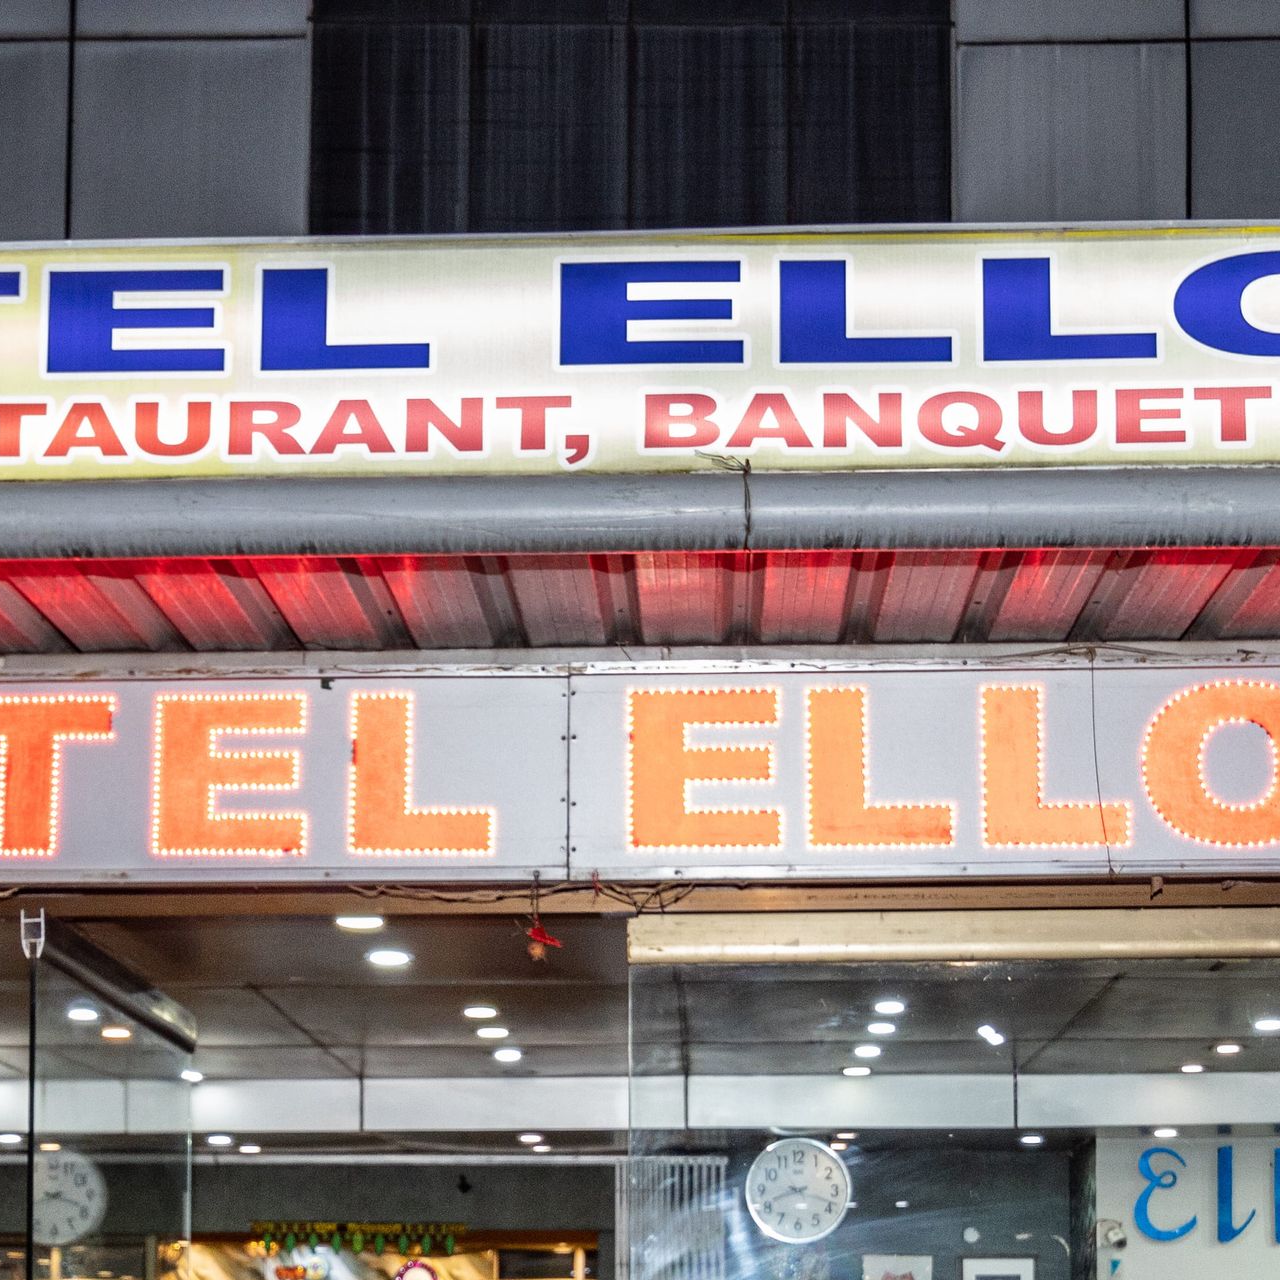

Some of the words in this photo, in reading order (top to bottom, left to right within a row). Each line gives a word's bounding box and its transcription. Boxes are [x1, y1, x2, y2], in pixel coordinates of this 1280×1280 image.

[644, 386, 1272, 453] BANQUET
[792, 1149, 805, 1164] 12
[764, 1167, 778, 1182] 10
[824, 1166, 833, 1180] 2
[757, 1183, 766, 1196] 9
[830, 1183, 839, 1198] 3
[763, 1200, 772, 1214] 8
[823, 1201, 832, 1214] 4
[776, 1211, 785, 1226] 7
[793, 1218, 802, 1231] 6
